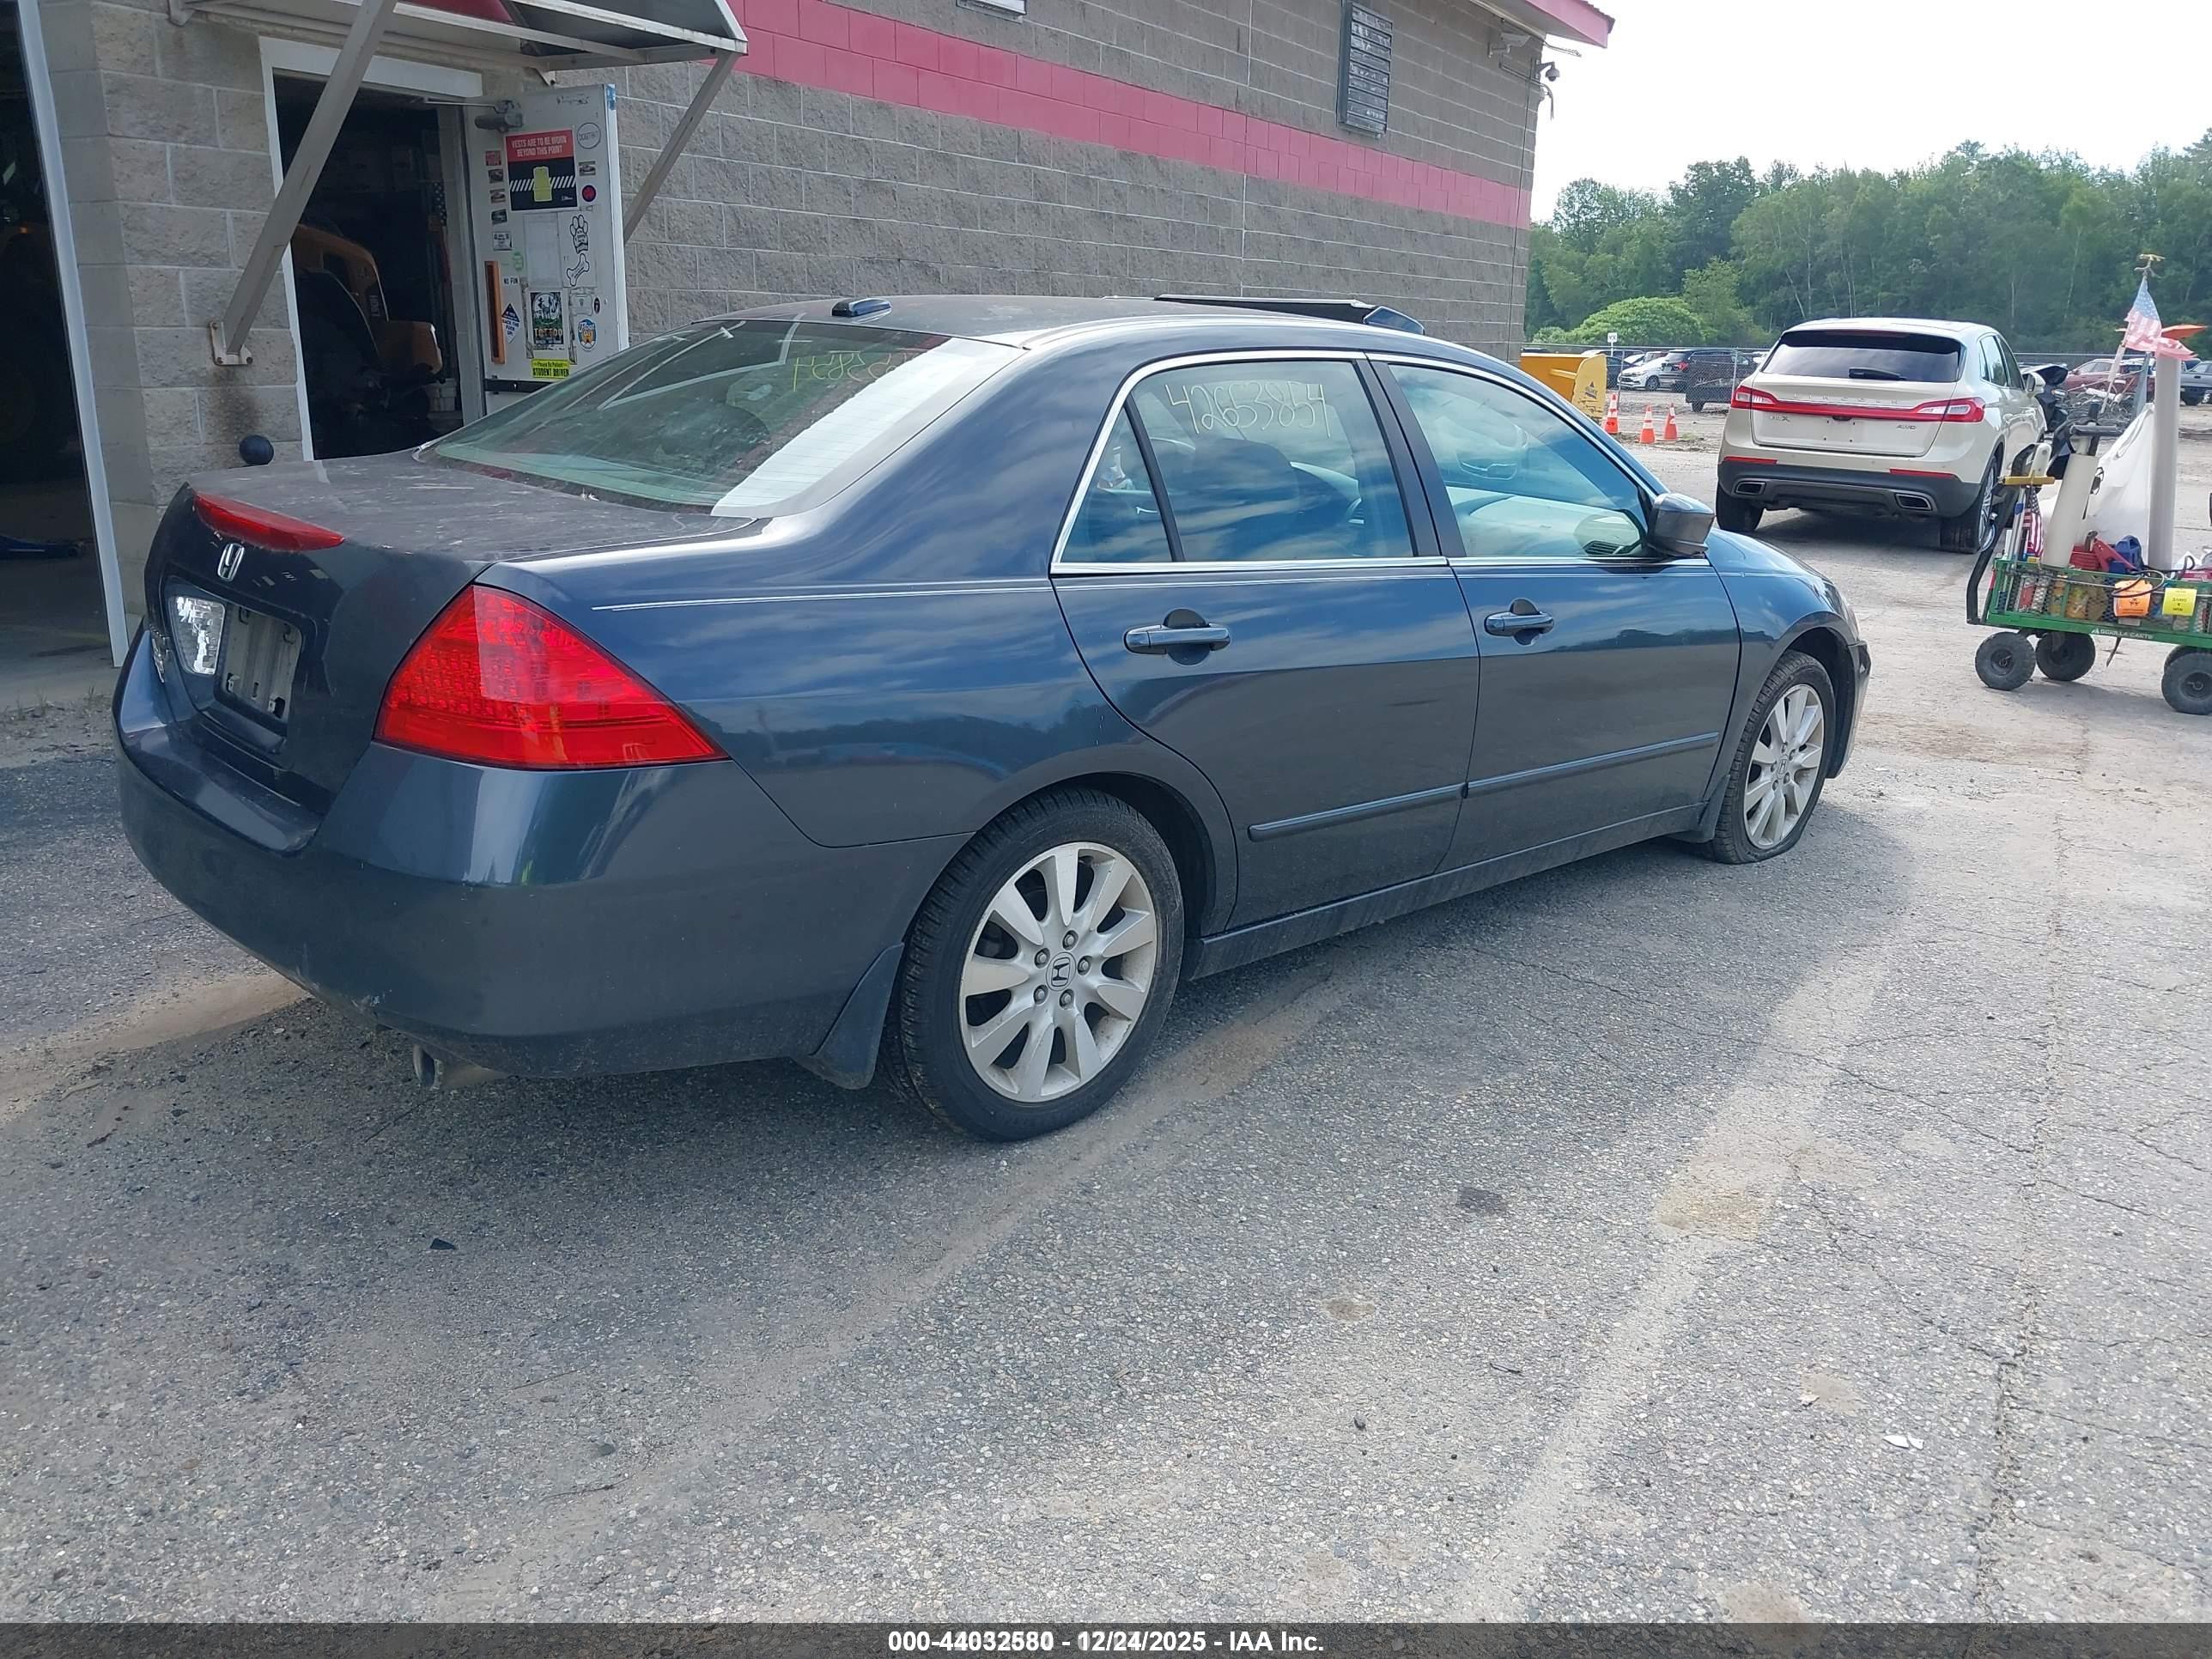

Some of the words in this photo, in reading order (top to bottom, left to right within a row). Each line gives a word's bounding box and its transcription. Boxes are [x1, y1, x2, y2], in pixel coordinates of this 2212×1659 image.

[511, 139, 526, 149] VESTS
[527, 137, 537, 148] ARE
[538, 137, 544, 146] TO
[544, 137, 551, 145] BE
[551, 135, 567, 145] WORN
[517, 148, 537, 157] BEYOND
[537, 146, 548, 155] THIS
[548, 144, 562, 155] POINT
[532, 368, 552, 377] STUDENT
[553, 368, 569, 378] DRIVER
[1164, 380, 1331, 439] 42653854
